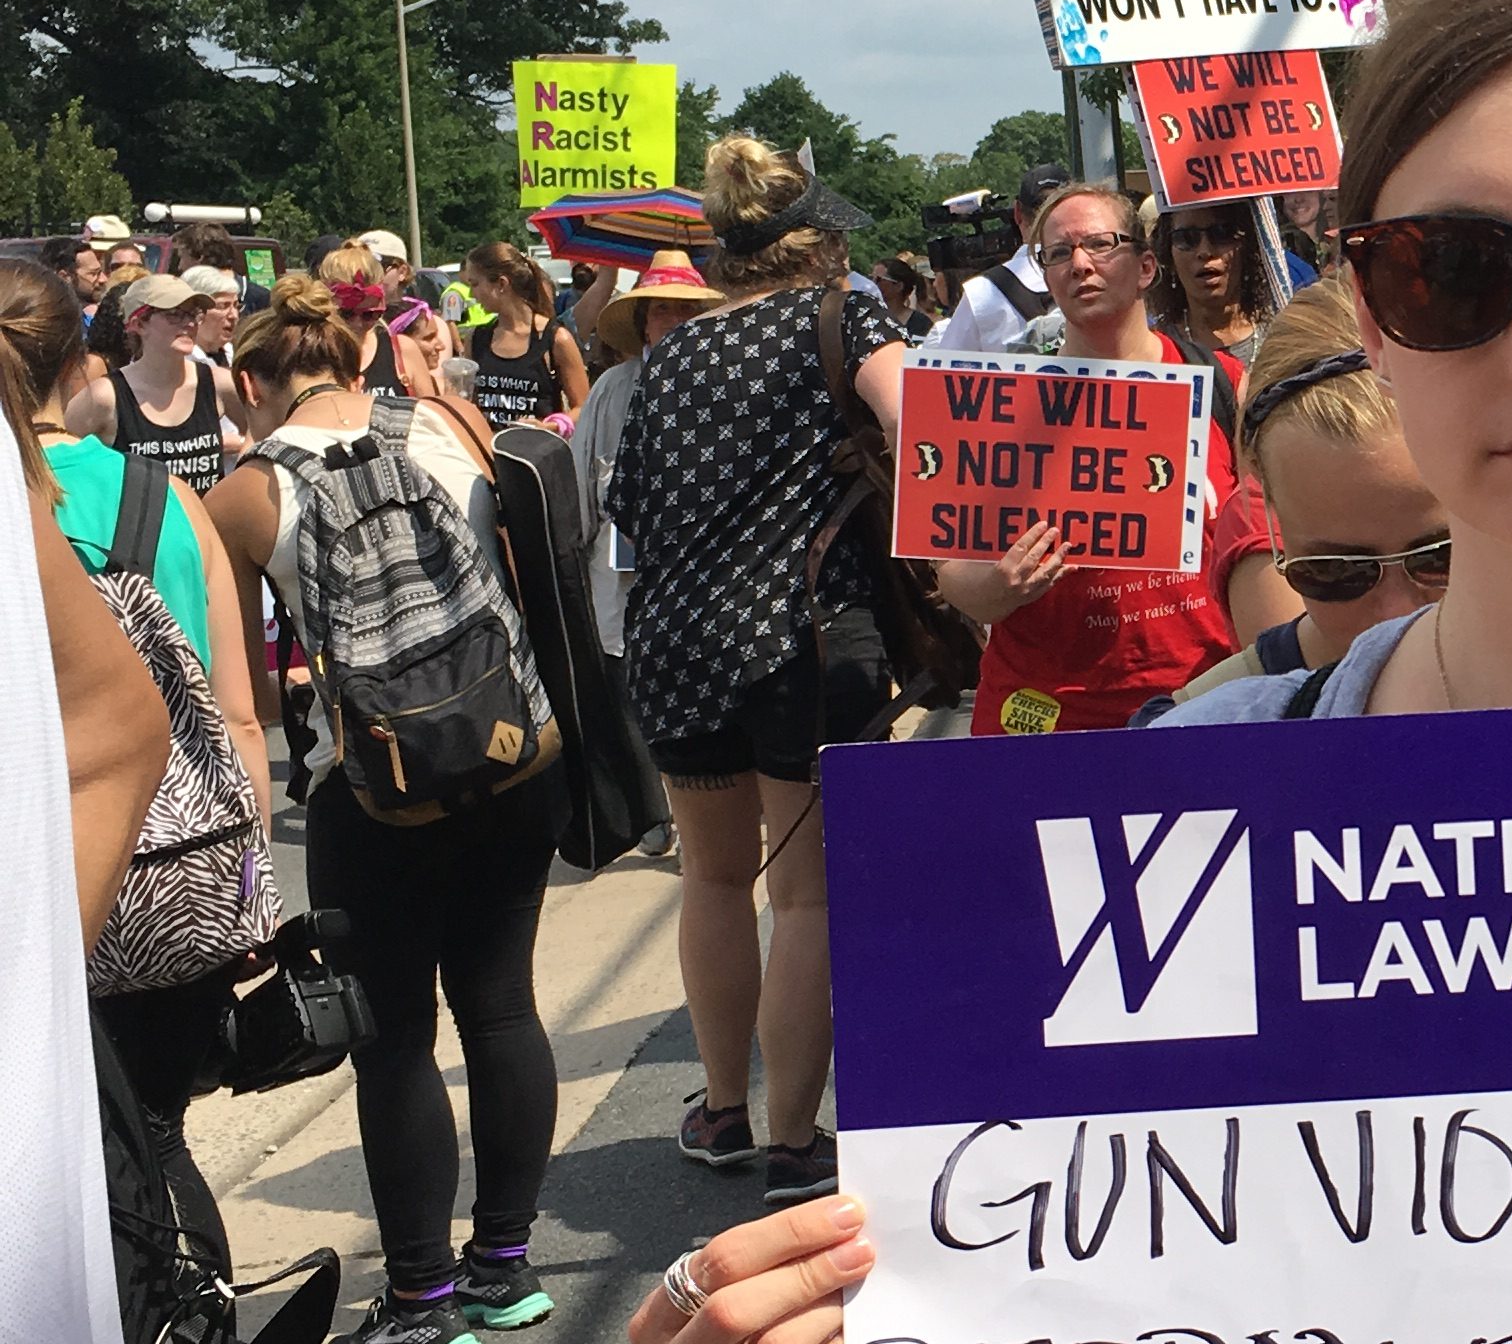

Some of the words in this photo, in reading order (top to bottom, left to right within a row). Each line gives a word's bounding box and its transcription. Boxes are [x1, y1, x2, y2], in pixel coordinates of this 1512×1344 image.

[1163, 56, 1219, 94] WE
[1224, 50, 1298, 88] WILL
[534, 81, 630, 120] Nasty
[532, 120, 631, 152] Racist
[1187, 102, 1252, 142] NOT
[1261, 99, 1300, 136] BE
[522, 159, 657, 189] Alarmists
[1185, 146, 1325, 193] SILENCED
[477, 393, 537, 411] EMINIST
[500, 377, 530, 392] WHAT
[530, 381, 539, 393] A
[944, 375, 1017, 424] WE
[1037, 379, 1147, 431] WILL
[129, 441, 160, 456] THIS
[163, 441, 174, 455] IS
[175, 434, 212, 453] WHAT
[213, 434, 219, 446] A
[957, 439, 1054, 490] NOT
[1071, 446, 1128, 493] BE
[1087, 585, 1121, 603] May
[1126, 580, 1143, 593] we
[1147, 572, 1161, 589] be
[1085, 615, 1119, 632] May
[1122, 611, 1140, 624] we
[1145, 602, 1176, 620] raise
[1180, 593, 1207, 612] them
[1010, 707, 1047, 727] SAVE
[931, 1118, 1240, 1272] GUN
